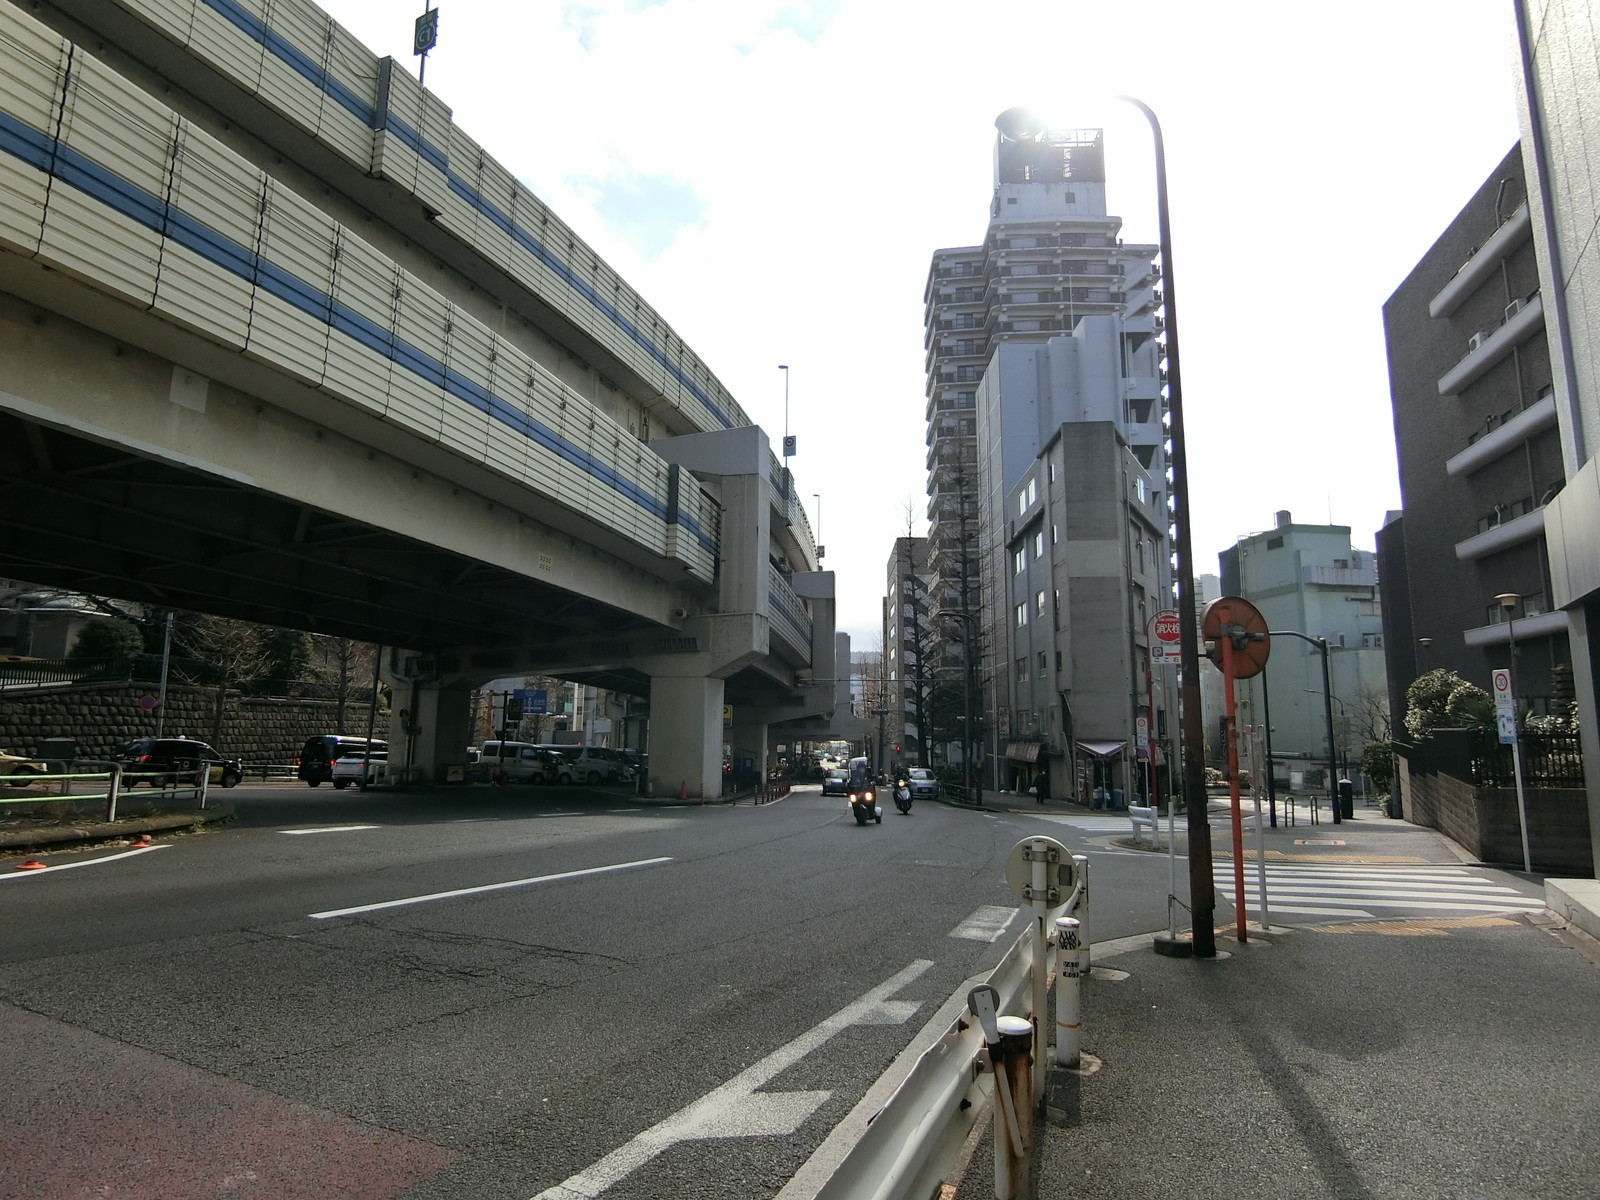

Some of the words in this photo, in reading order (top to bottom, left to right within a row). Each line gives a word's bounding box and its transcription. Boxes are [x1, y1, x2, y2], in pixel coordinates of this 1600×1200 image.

[419, 28, 430, 42] C1
[1156, 622, 1180, 634] 消火栓
